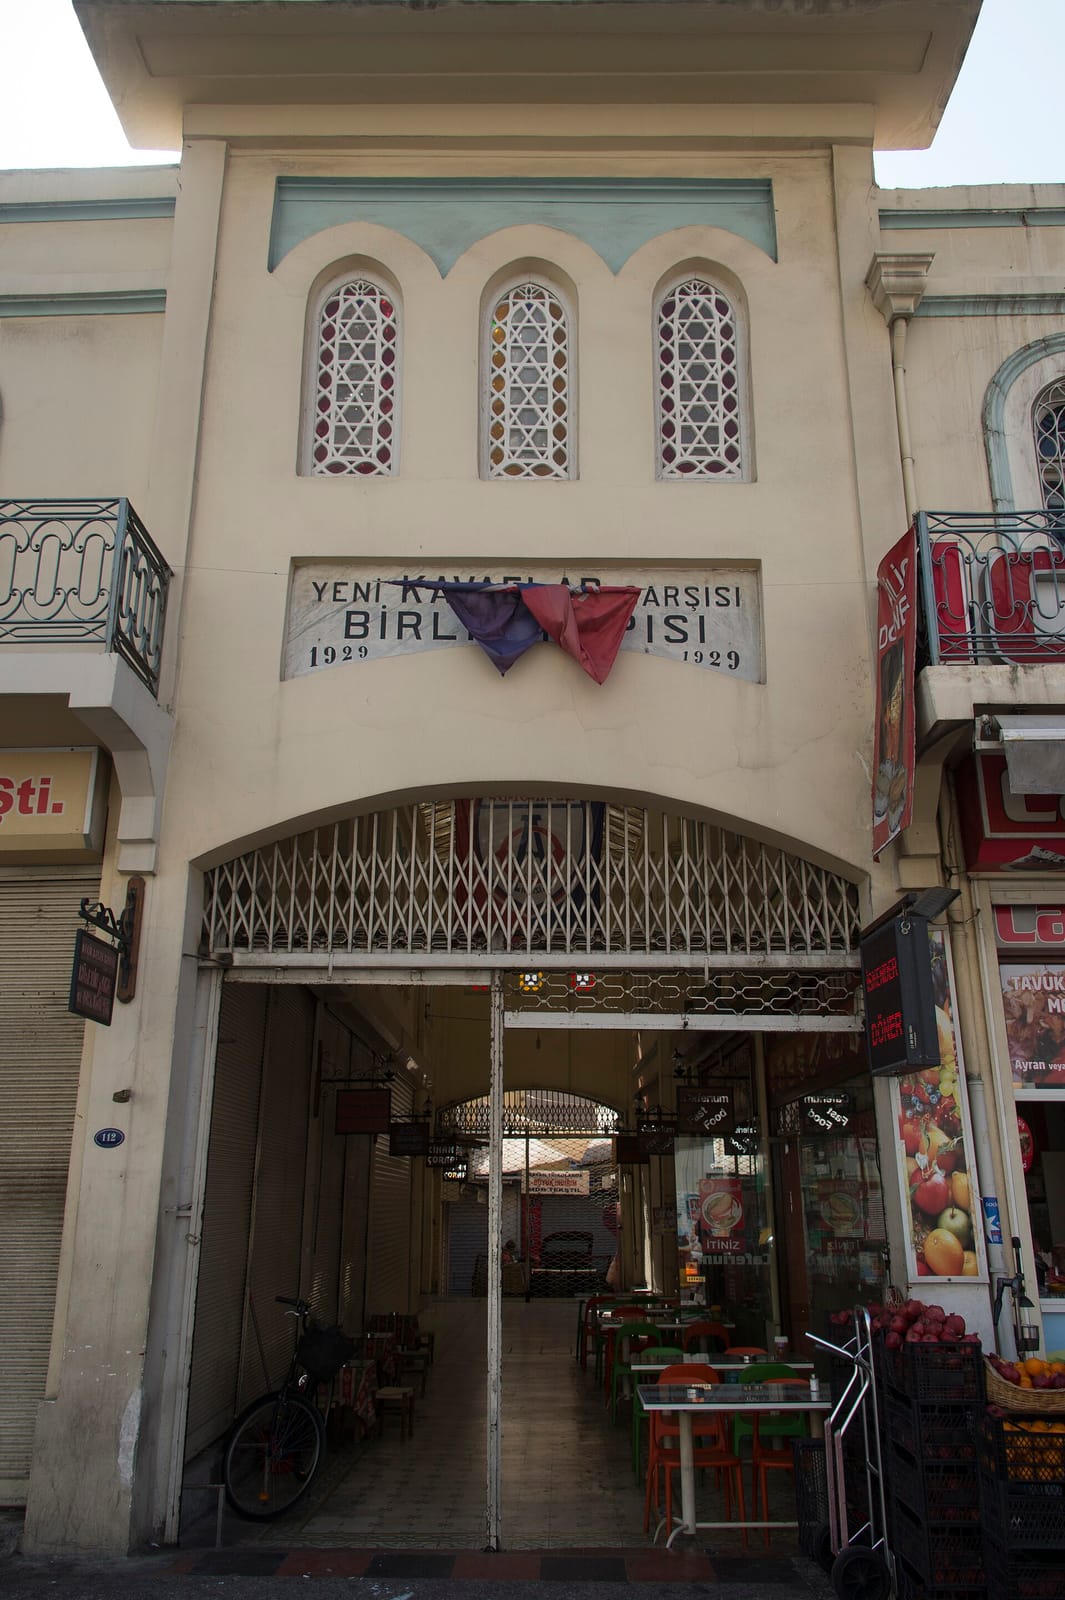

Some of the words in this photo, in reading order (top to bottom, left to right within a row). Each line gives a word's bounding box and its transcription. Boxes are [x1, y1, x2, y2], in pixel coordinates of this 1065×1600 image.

[311, 577, 382, 603] YENİ
[628, 585, 741, 612] ARŞISI
[344, 604, 475, 641] BİRL
[309, 645, 369, 668] 1929
[683, 650, 741, 670] 1929
[1011, 975, 1065, 991] TAVUK
[1015, 1059, 1046, 1072] Ayran
[703, 1107, 729, 1131] Food
[101, 1132, 117, 1142] 112
